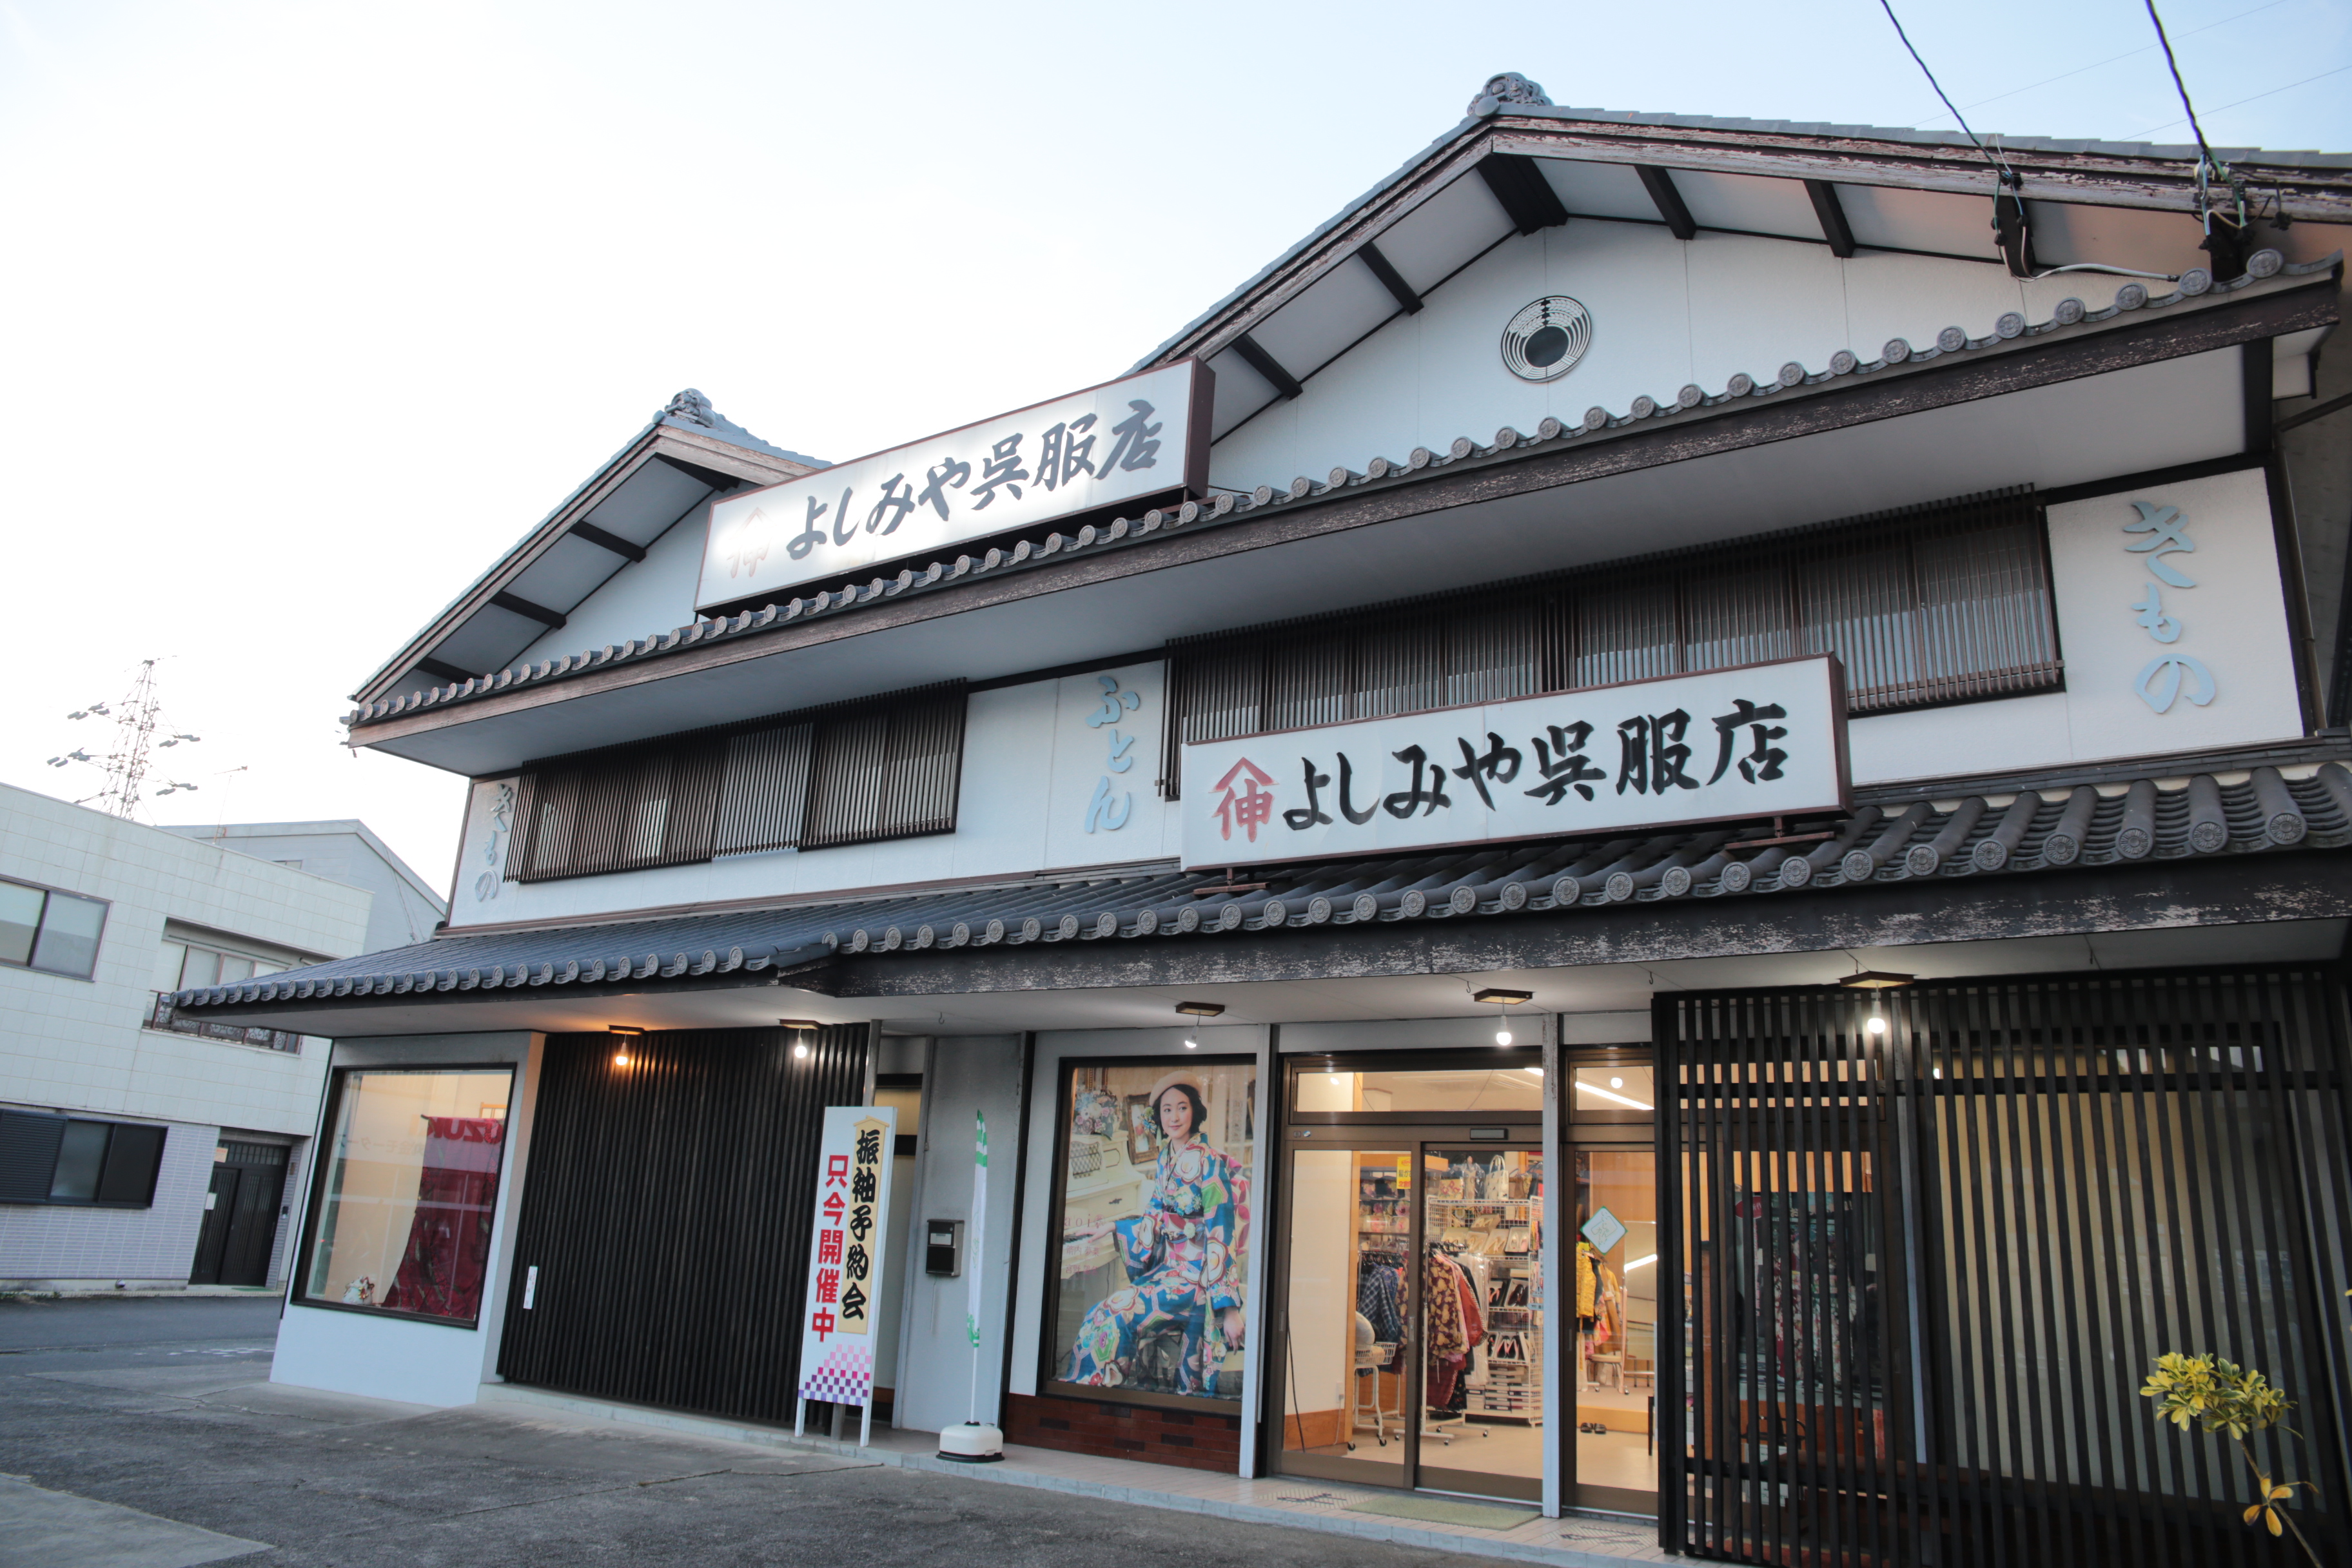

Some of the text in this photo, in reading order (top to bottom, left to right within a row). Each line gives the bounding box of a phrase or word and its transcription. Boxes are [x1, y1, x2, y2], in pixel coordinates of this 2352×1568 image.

[786, 399, 1163, 560] よしみや呉服店
[1084, 676, 1141, 834] ふとん
[1282, 698, 1788, 832] よしみや呉服店
[812, 1155, 850, 1342] 只今開催中
[841, 1129, 881, 1320] 振袖予約会
